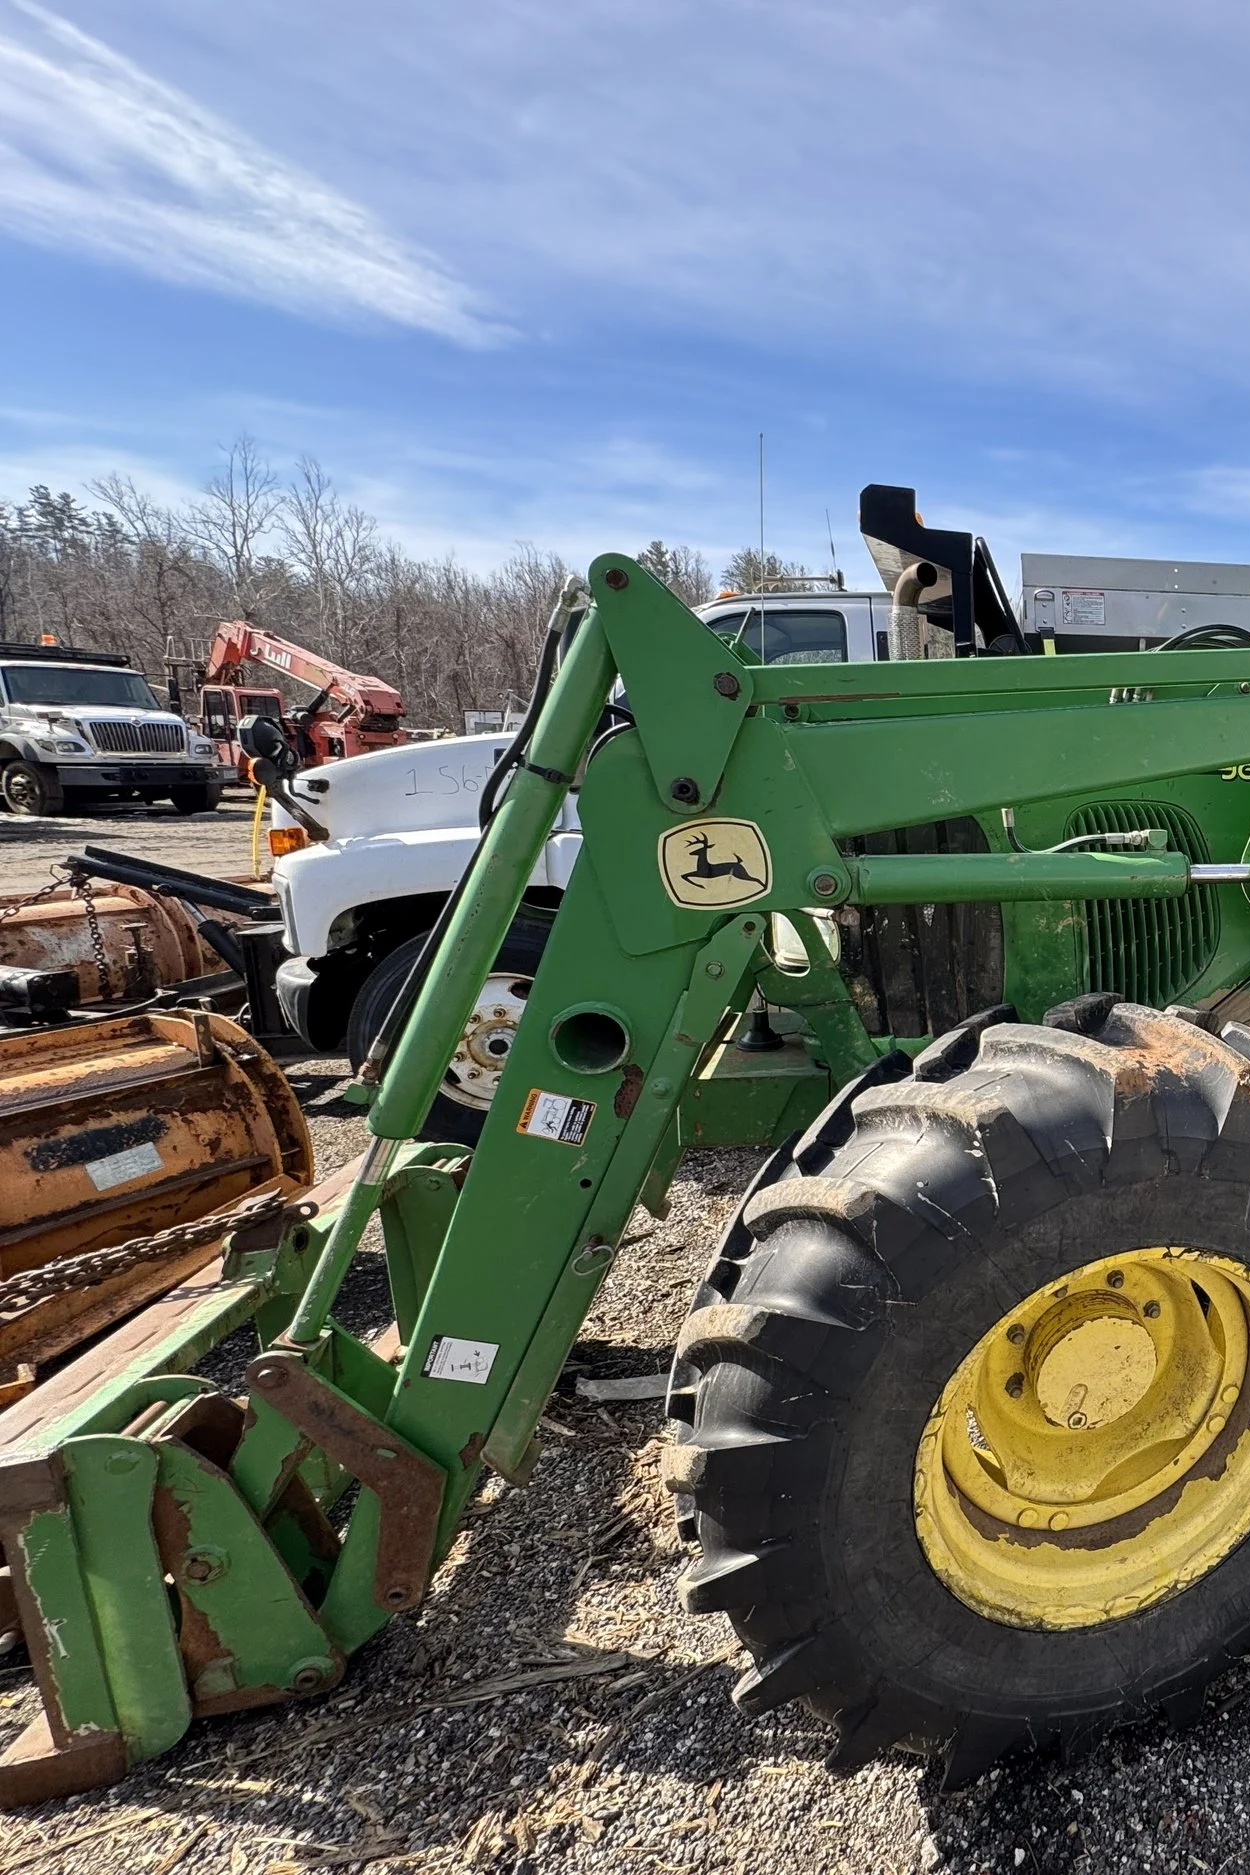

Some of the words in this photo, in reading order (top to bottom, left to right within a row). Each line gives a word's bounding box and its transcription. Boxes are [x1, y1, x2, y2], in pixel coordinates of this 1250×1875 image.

[264, 643, 292, 669] Lull
[524, 1093, 538, 1120] WARNING
[423, 1341, 440, 1371] IMPORTANT
